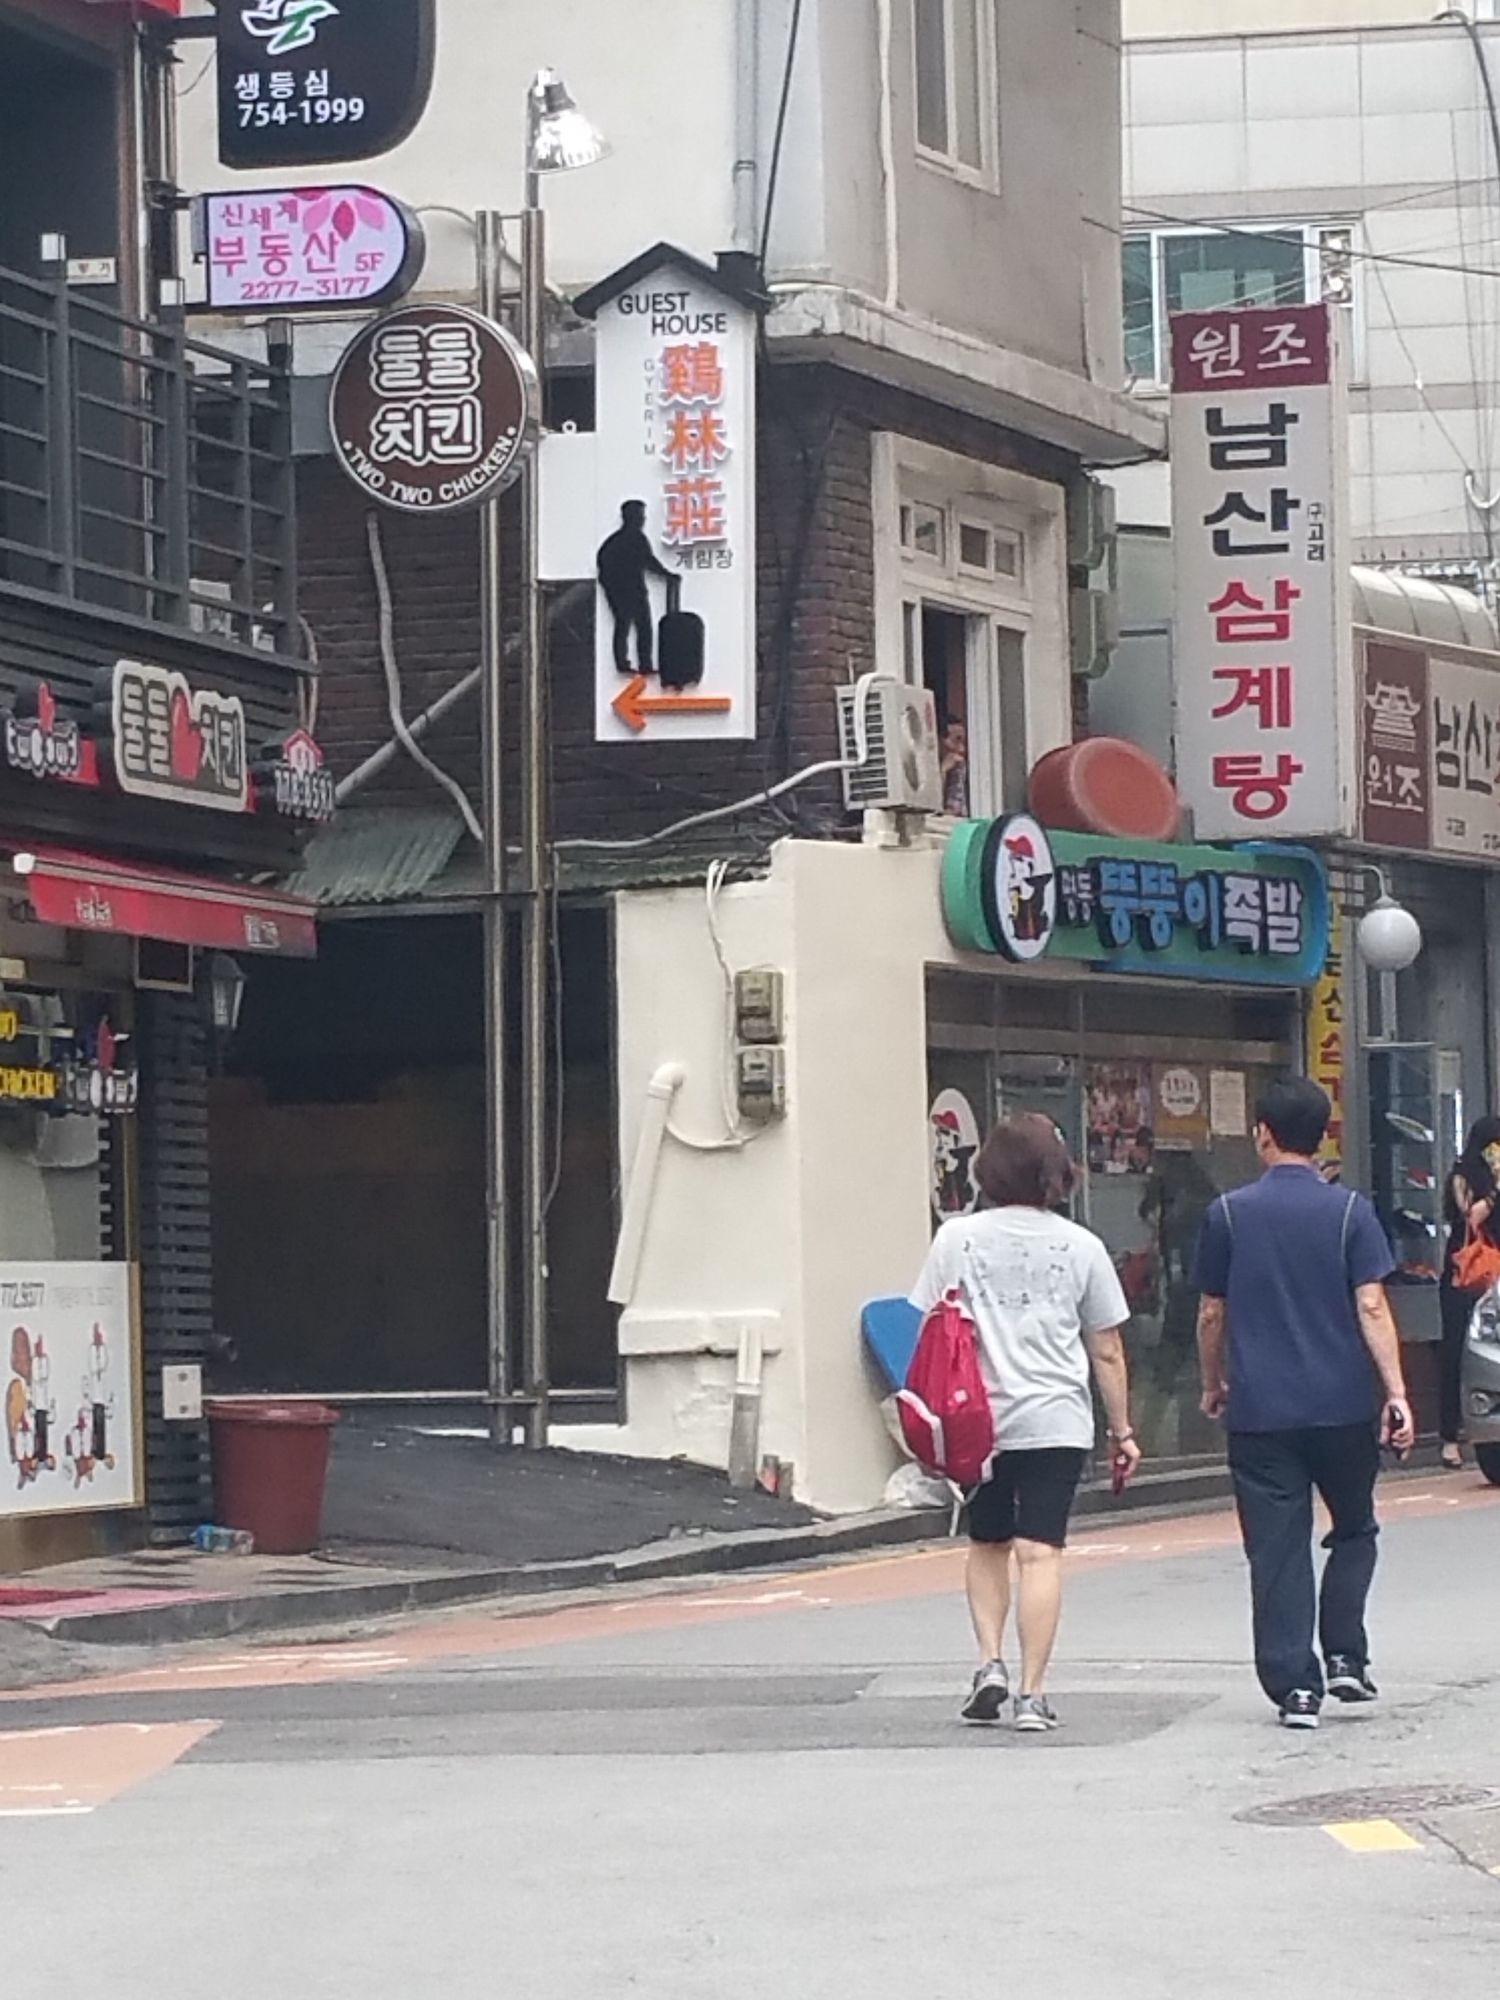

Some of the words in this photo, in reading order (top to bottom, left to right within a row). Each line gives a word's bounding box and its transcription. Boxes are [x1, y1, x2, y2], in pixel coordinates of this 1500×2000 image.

[235, 69, 329, 101] 생등심
[238, 98, 364, 127] 754-1999
[219, 200, 299, 230] 신세계
[212, 232, 341, 278] 부동산
[354, 252, 385, 272] 5F
[241, 277, 371, 300] 2277-3177
[617, 292, 690, 316] GUEST
[651, 313, 728, 336] HOUSE
[376, 329, 475, 391] 둘둘
[1187, 322, 1313, 379] 원조
[376, 402, 475, 458] 치킨
[349, 447, 386, 489] TWO
[389, 482, 433, 505] TWO
[439, 435, 513, 502] CHICKEN
[1364, 753, 1424, 813] 원조
[1224, 875, 1303, 955] 족발
